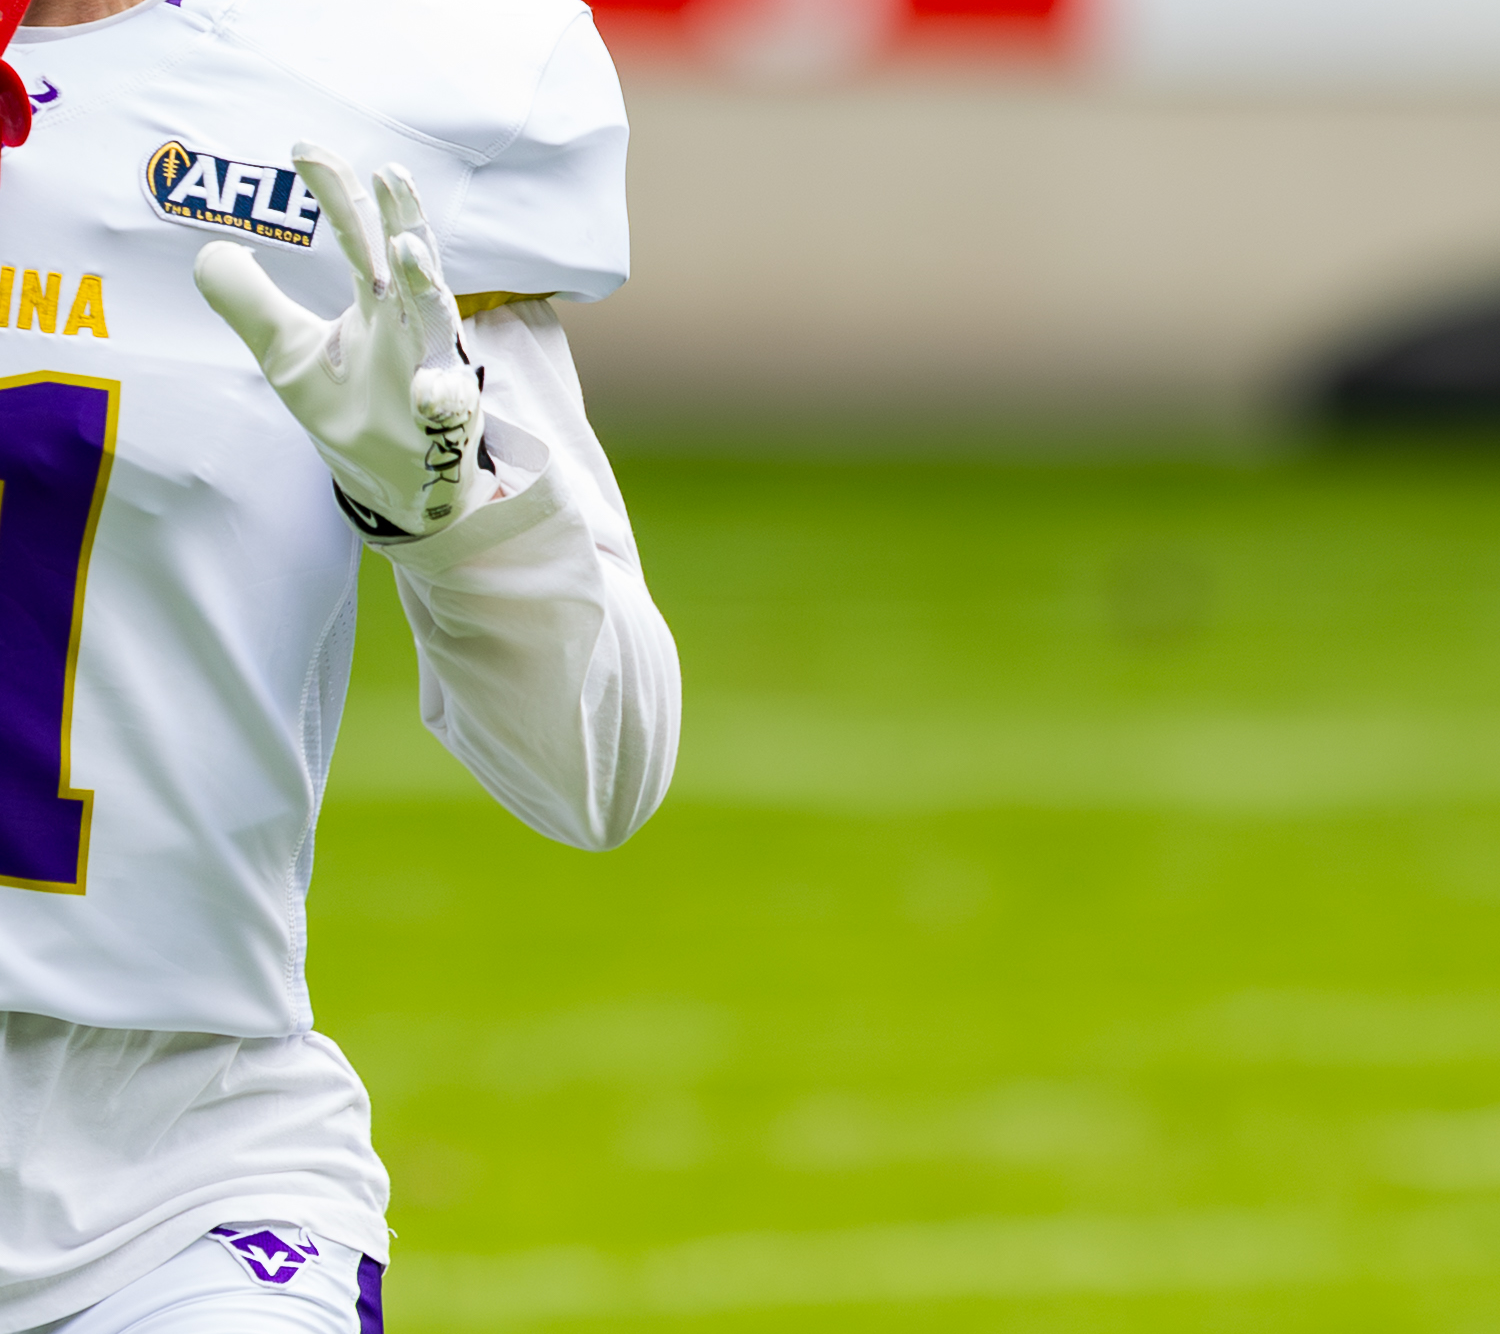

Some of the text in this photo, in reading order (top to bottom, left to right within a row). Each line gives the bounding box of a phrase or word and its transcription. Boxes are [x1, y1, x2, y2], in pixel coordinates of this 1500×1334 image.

[164, 201, 311, 246] THE LEAGUE EUROPE
[166, 153, 319, 234] AFLE
